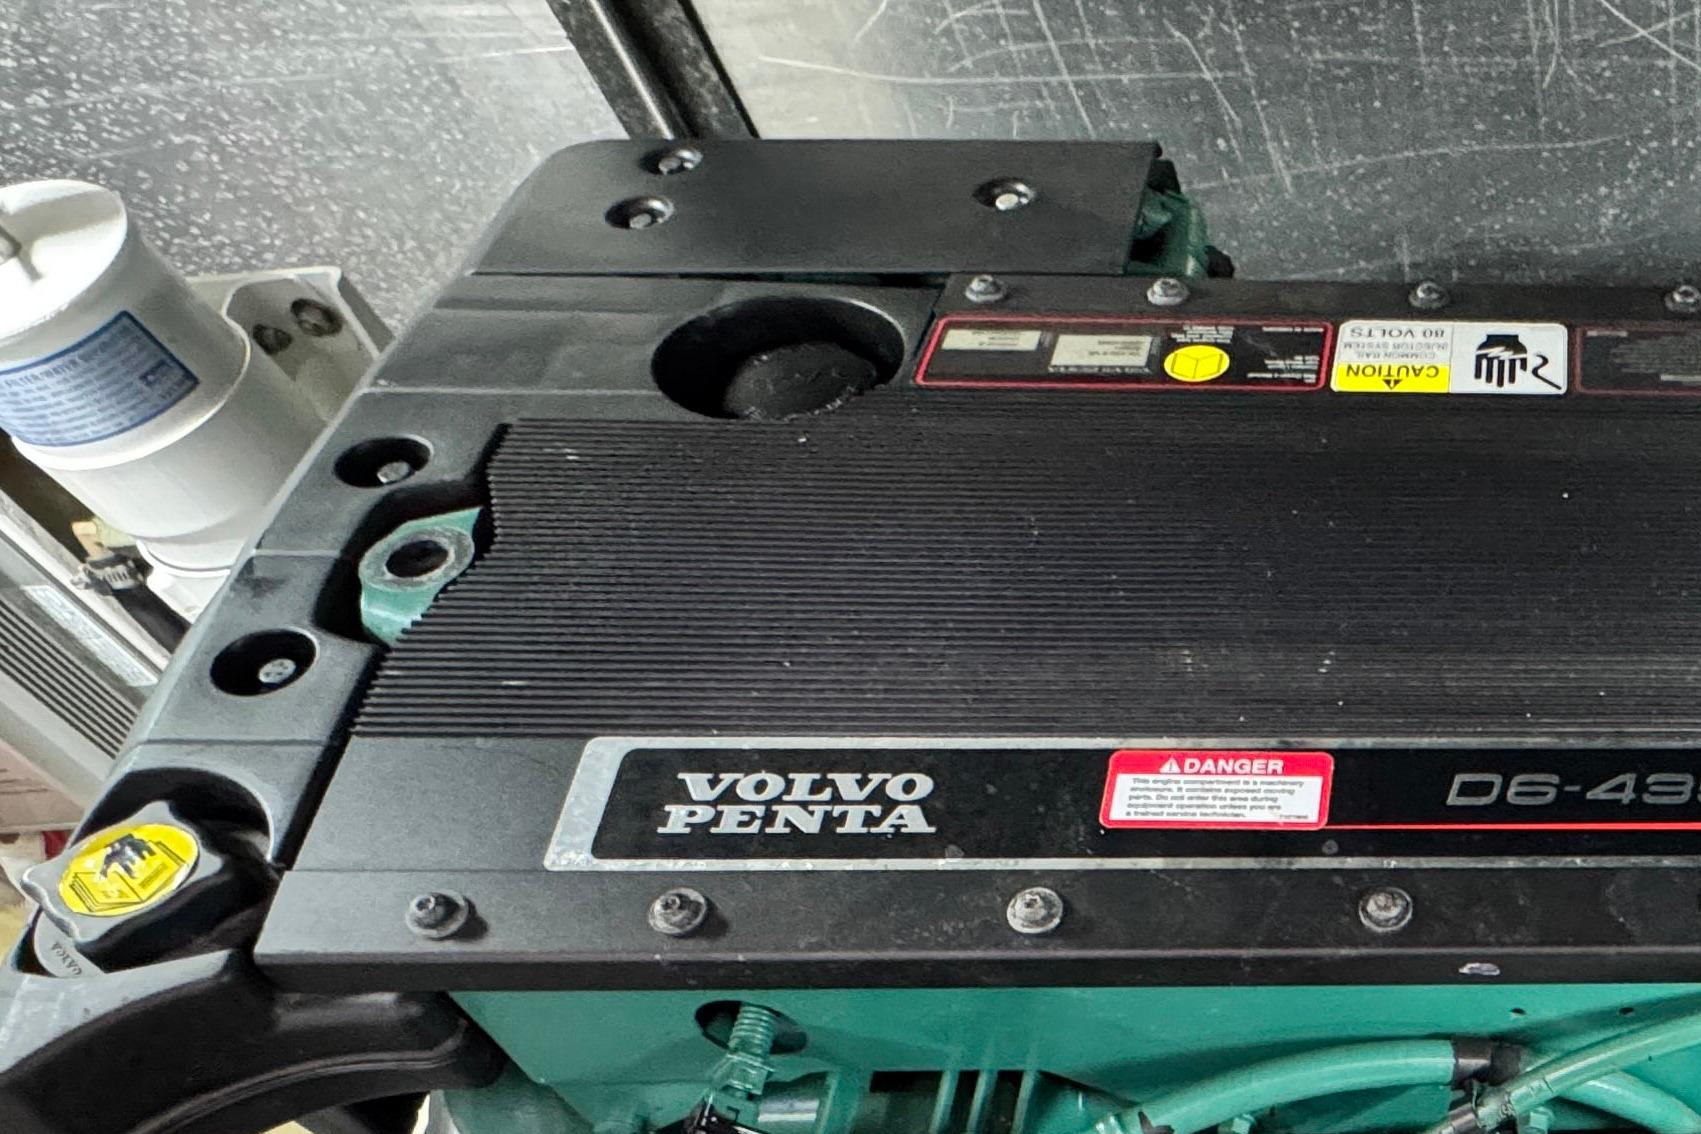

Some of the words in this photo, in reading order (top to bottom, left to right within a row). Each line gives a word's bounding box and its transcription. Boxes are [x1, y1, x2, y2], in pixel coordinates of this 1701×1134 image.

[1350, 327, 1415, 339] VOLTS
[1346, 364, 1439, 378] CAUTION
[1184, 758, 1284, 775] DANGER
[677, 771, 934, 801] VOLVO
[657, 805, 937, 834] PENTA
